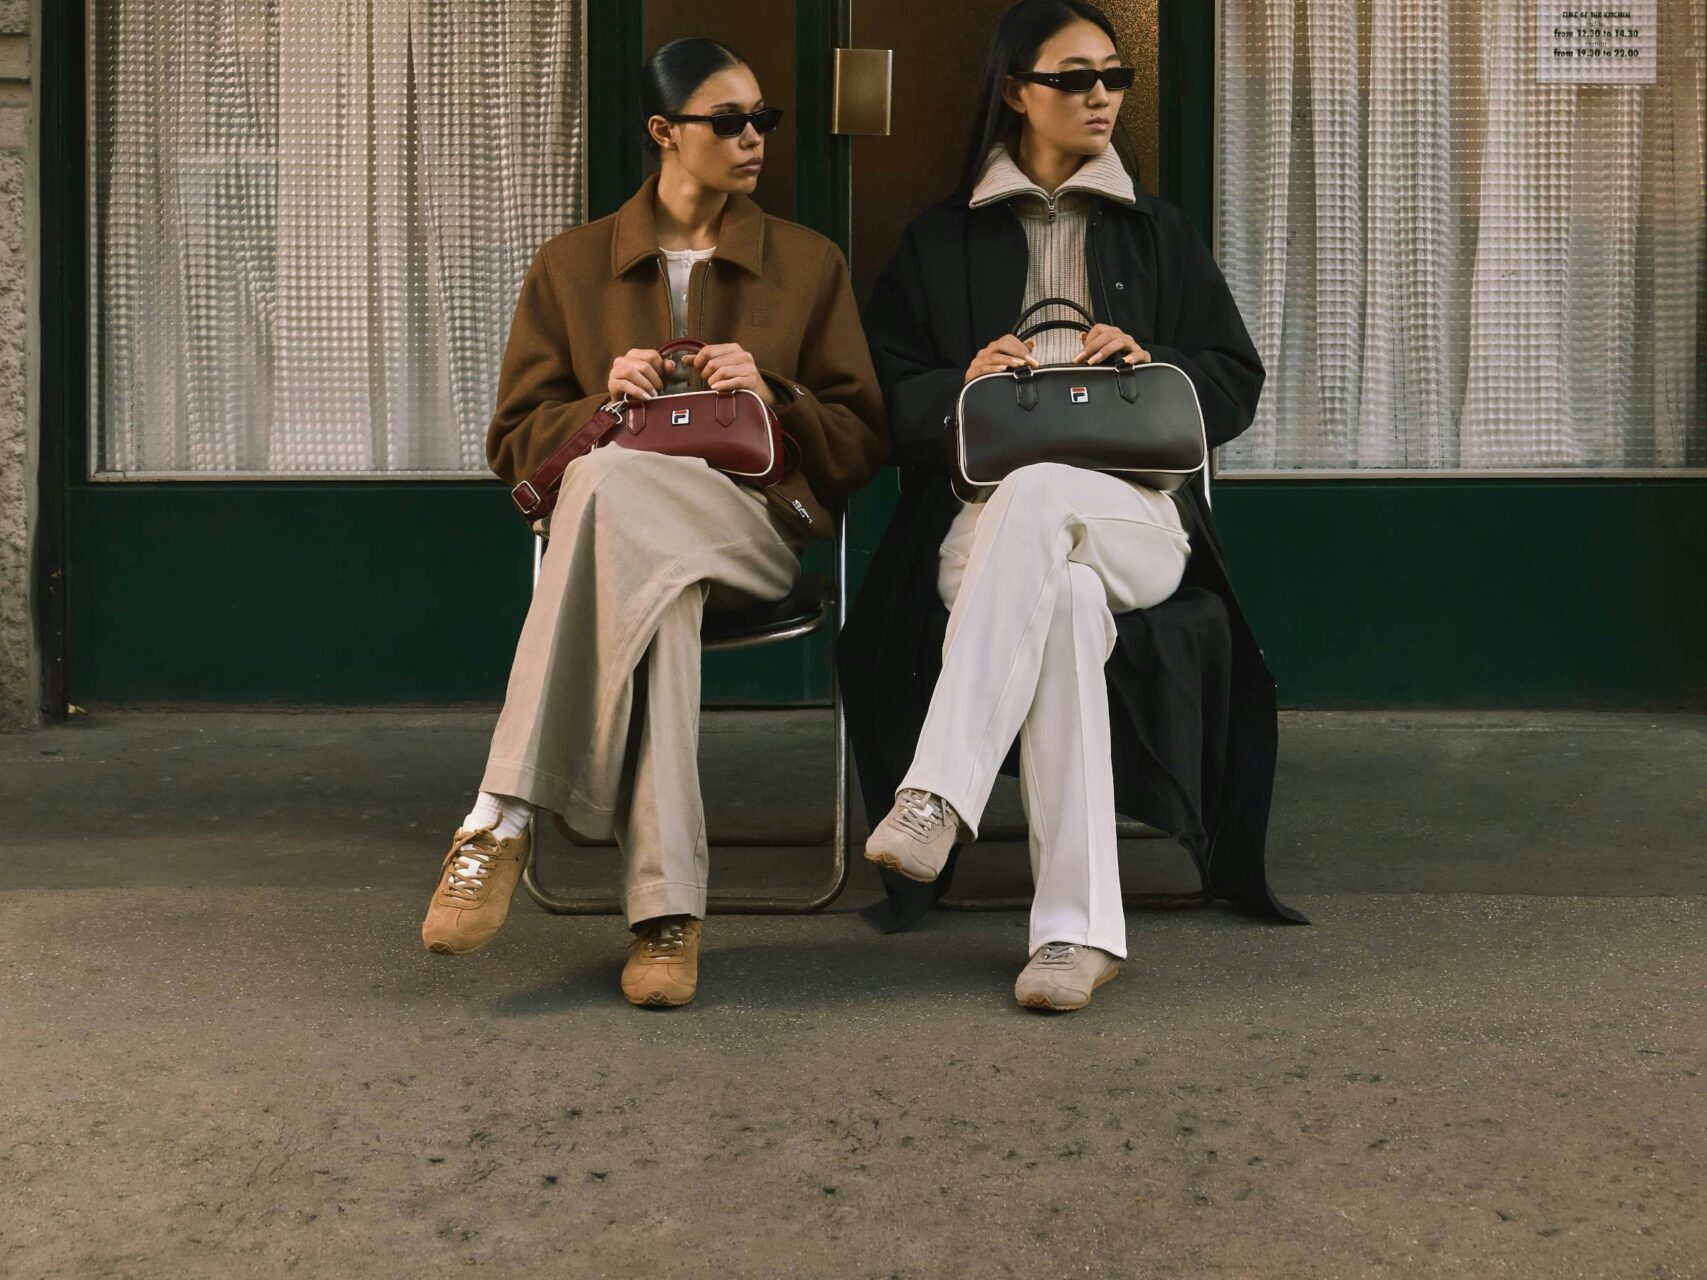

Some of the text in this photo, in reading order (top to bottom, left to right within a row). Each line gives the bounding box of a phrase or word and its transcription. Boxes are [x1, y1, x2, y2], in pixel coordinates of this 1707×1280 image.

[1553, 29, 1639, 38] from 12.30 to 14.30
[1553, 49, 1639, 57] from 19.30 to 22.00
